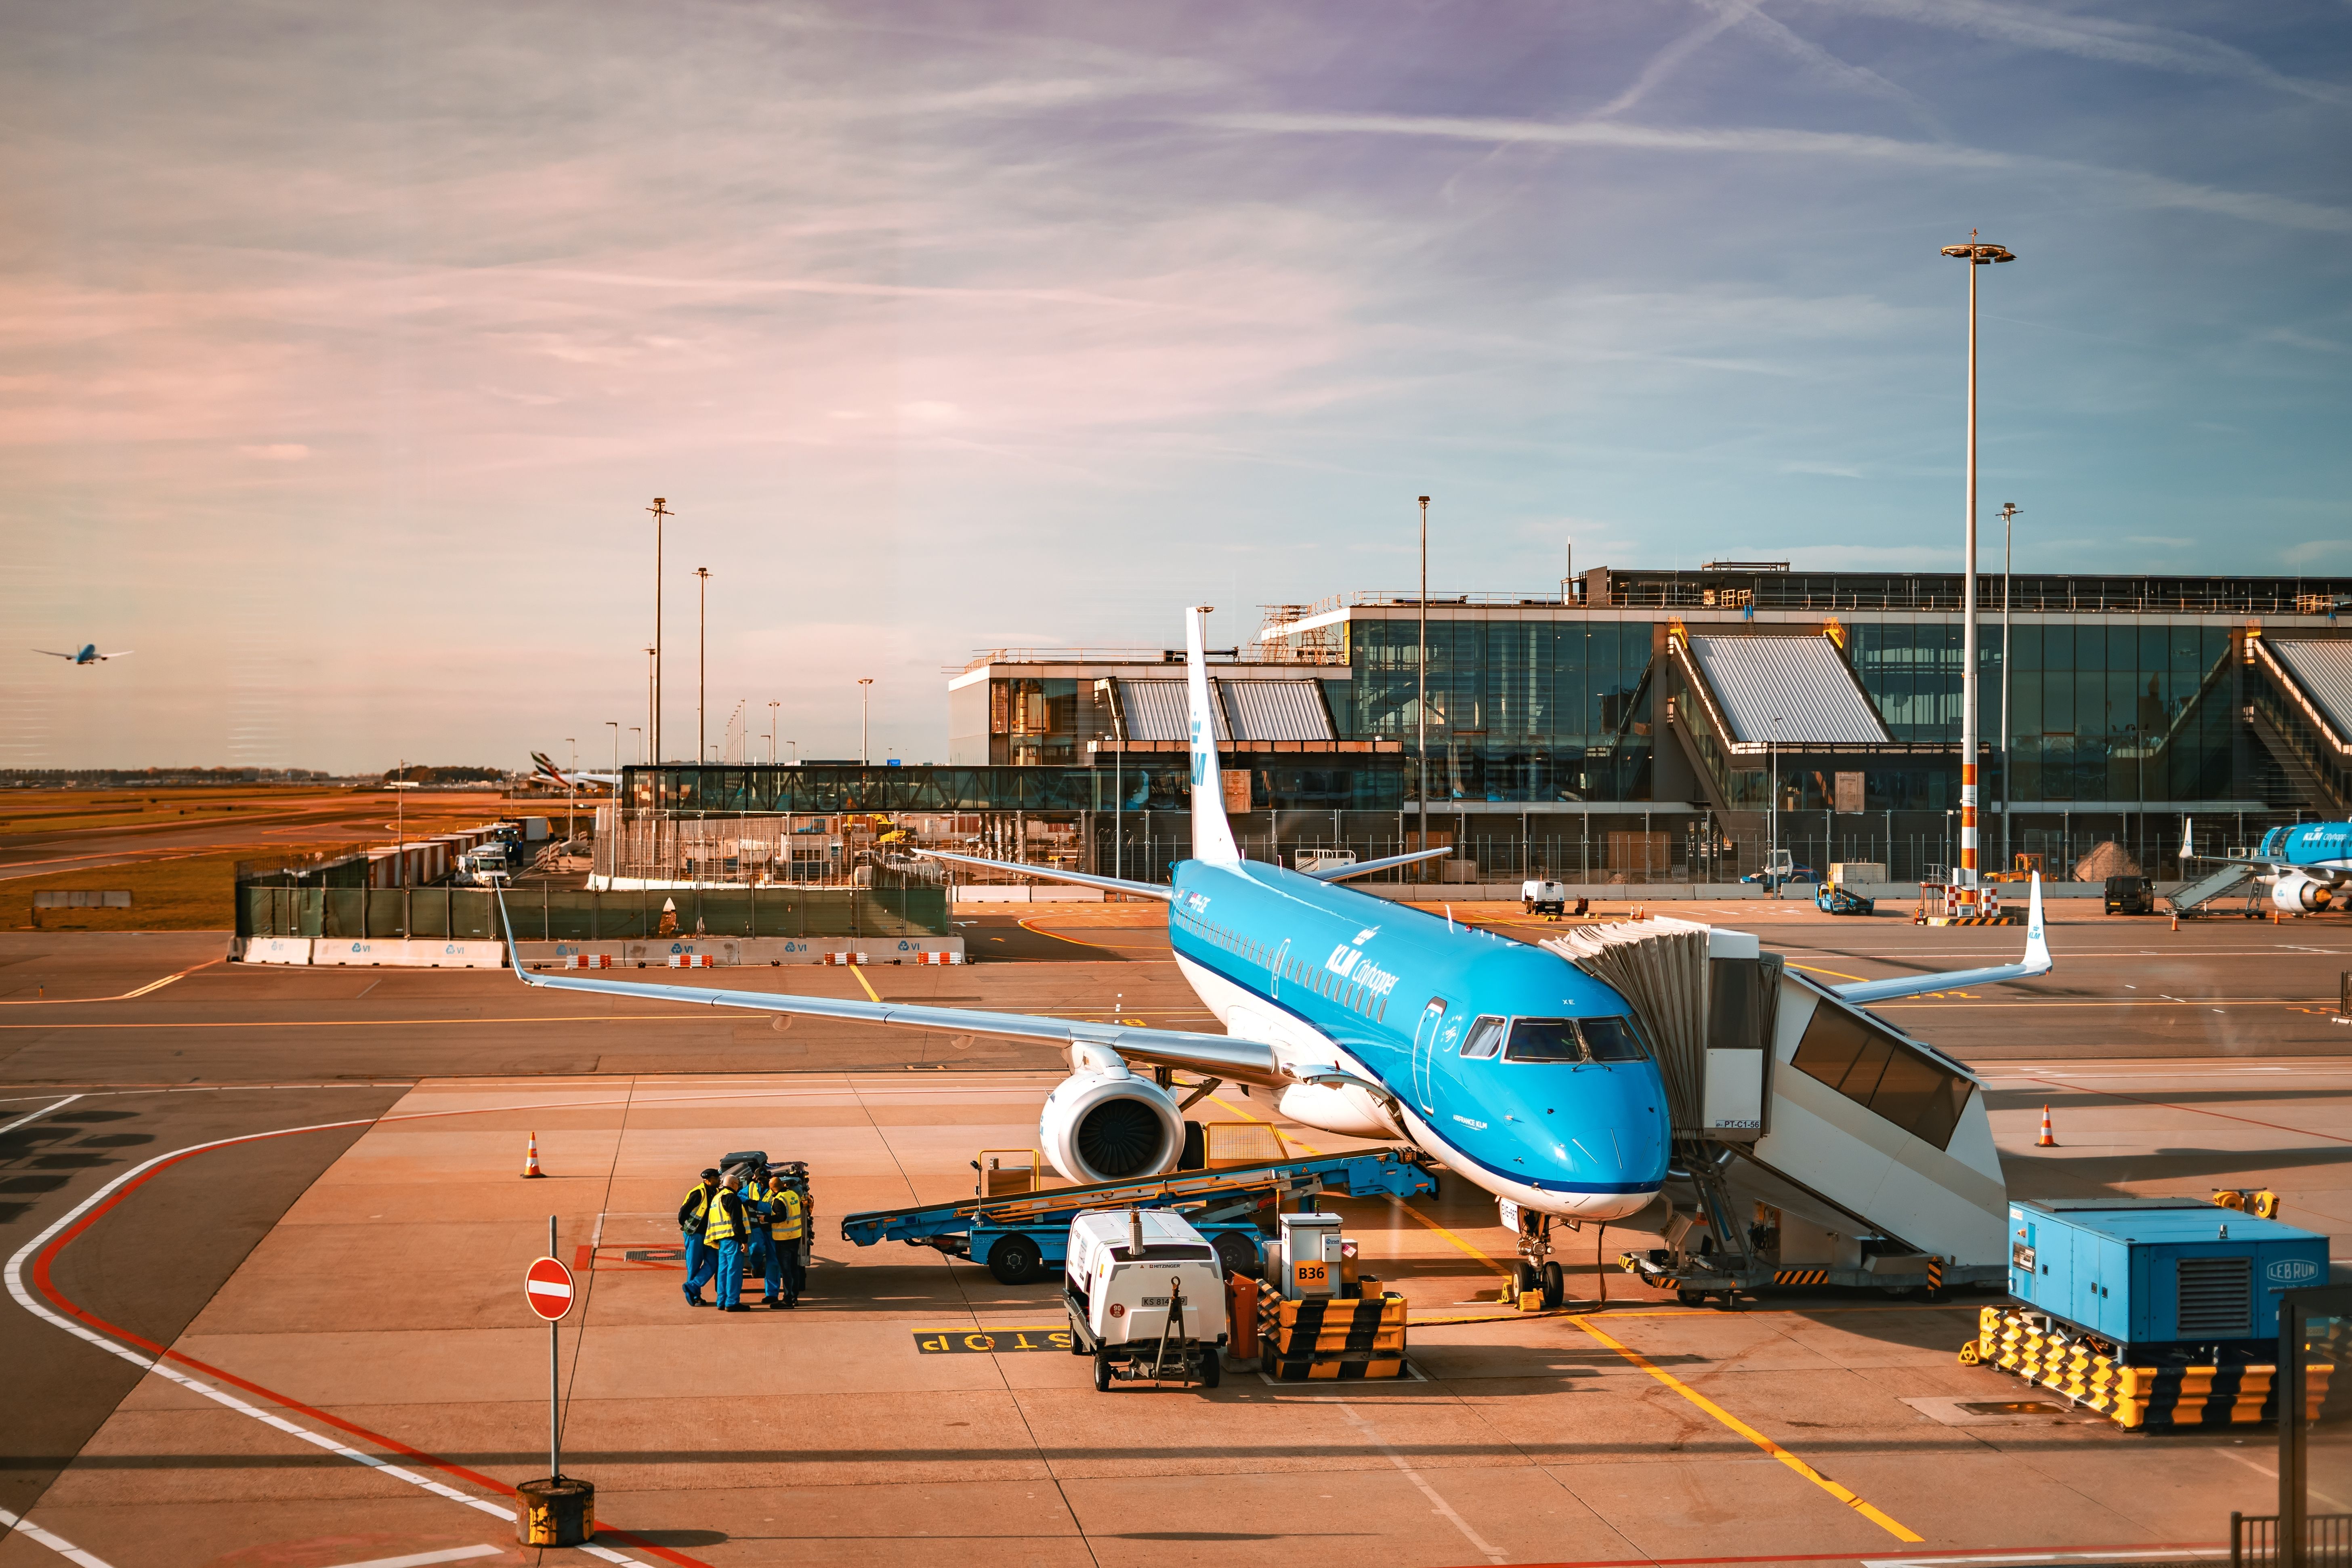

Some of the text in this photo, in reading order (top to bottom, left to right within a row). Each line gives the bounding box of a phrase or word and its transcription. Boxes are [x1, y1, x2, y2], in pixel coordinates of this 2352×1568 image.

[1191, 751, 1207, 786] LM
[2302, 832, 2324, 840] KLM
[1325, 944, 1363, 978] KLM
[1476, 1121, 1487, 1129] KLM
[1299, 1267, 1325, 1279] B36
[2270, 1263, 2315, 1279] LEBRUN
[922, 1333, 1071, 1350] STOP
